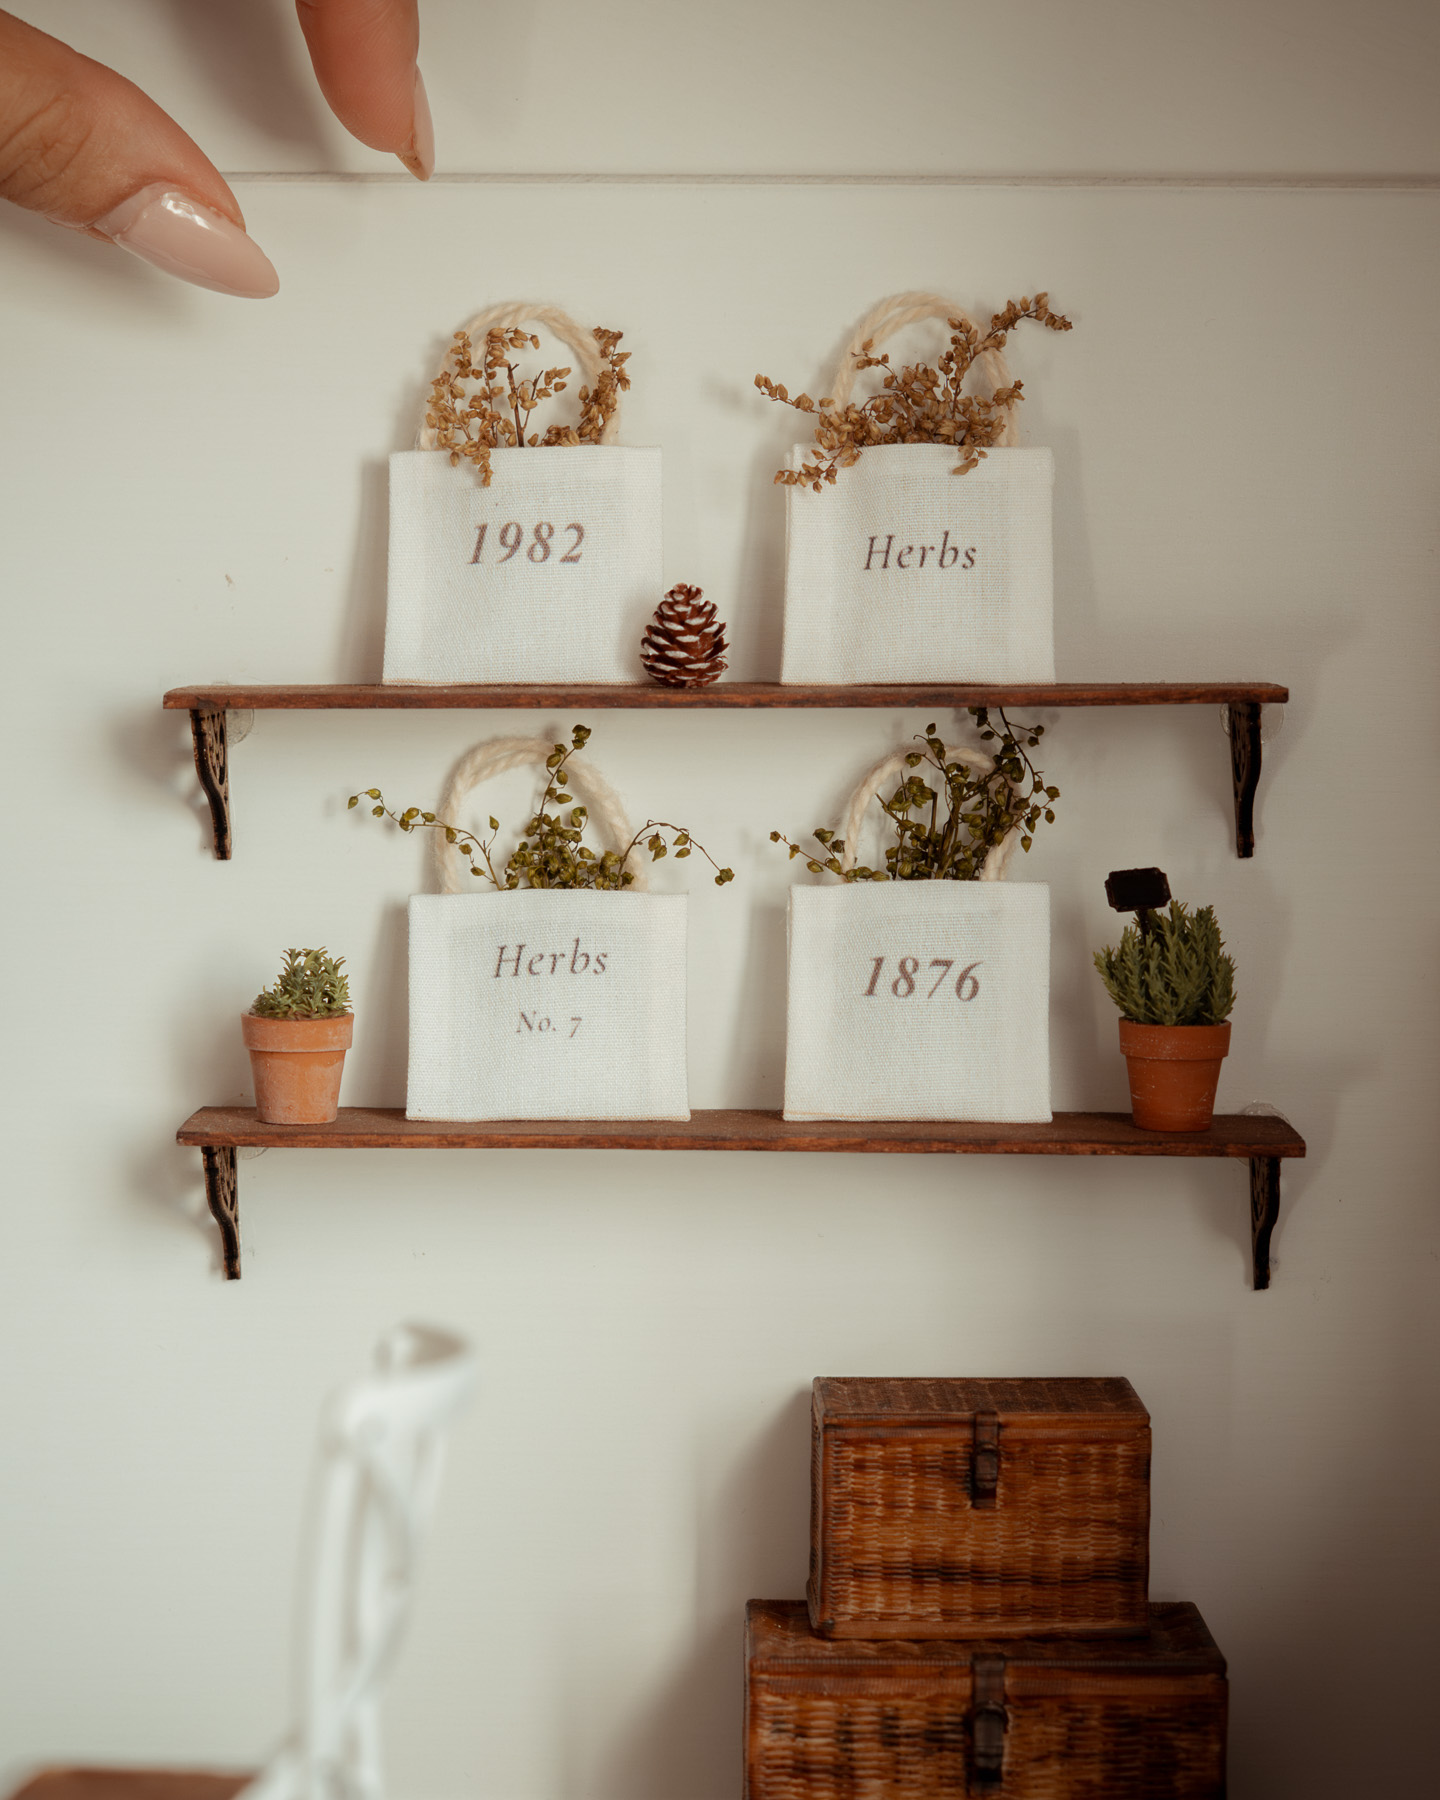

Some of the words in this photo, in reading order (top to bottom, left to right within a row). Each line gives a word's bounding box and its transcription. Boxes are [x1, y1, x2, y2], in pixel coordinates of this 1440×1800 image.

[469, 522, 586, 565] 1982
[863, 530, 977, 571] Herbs
[494, 937, 608, 978] Herbs
[864, 956, 983, 1002] 1876
[516, 1010, 557, 1034] No.
[569, 1016, 583, 1039] 7
